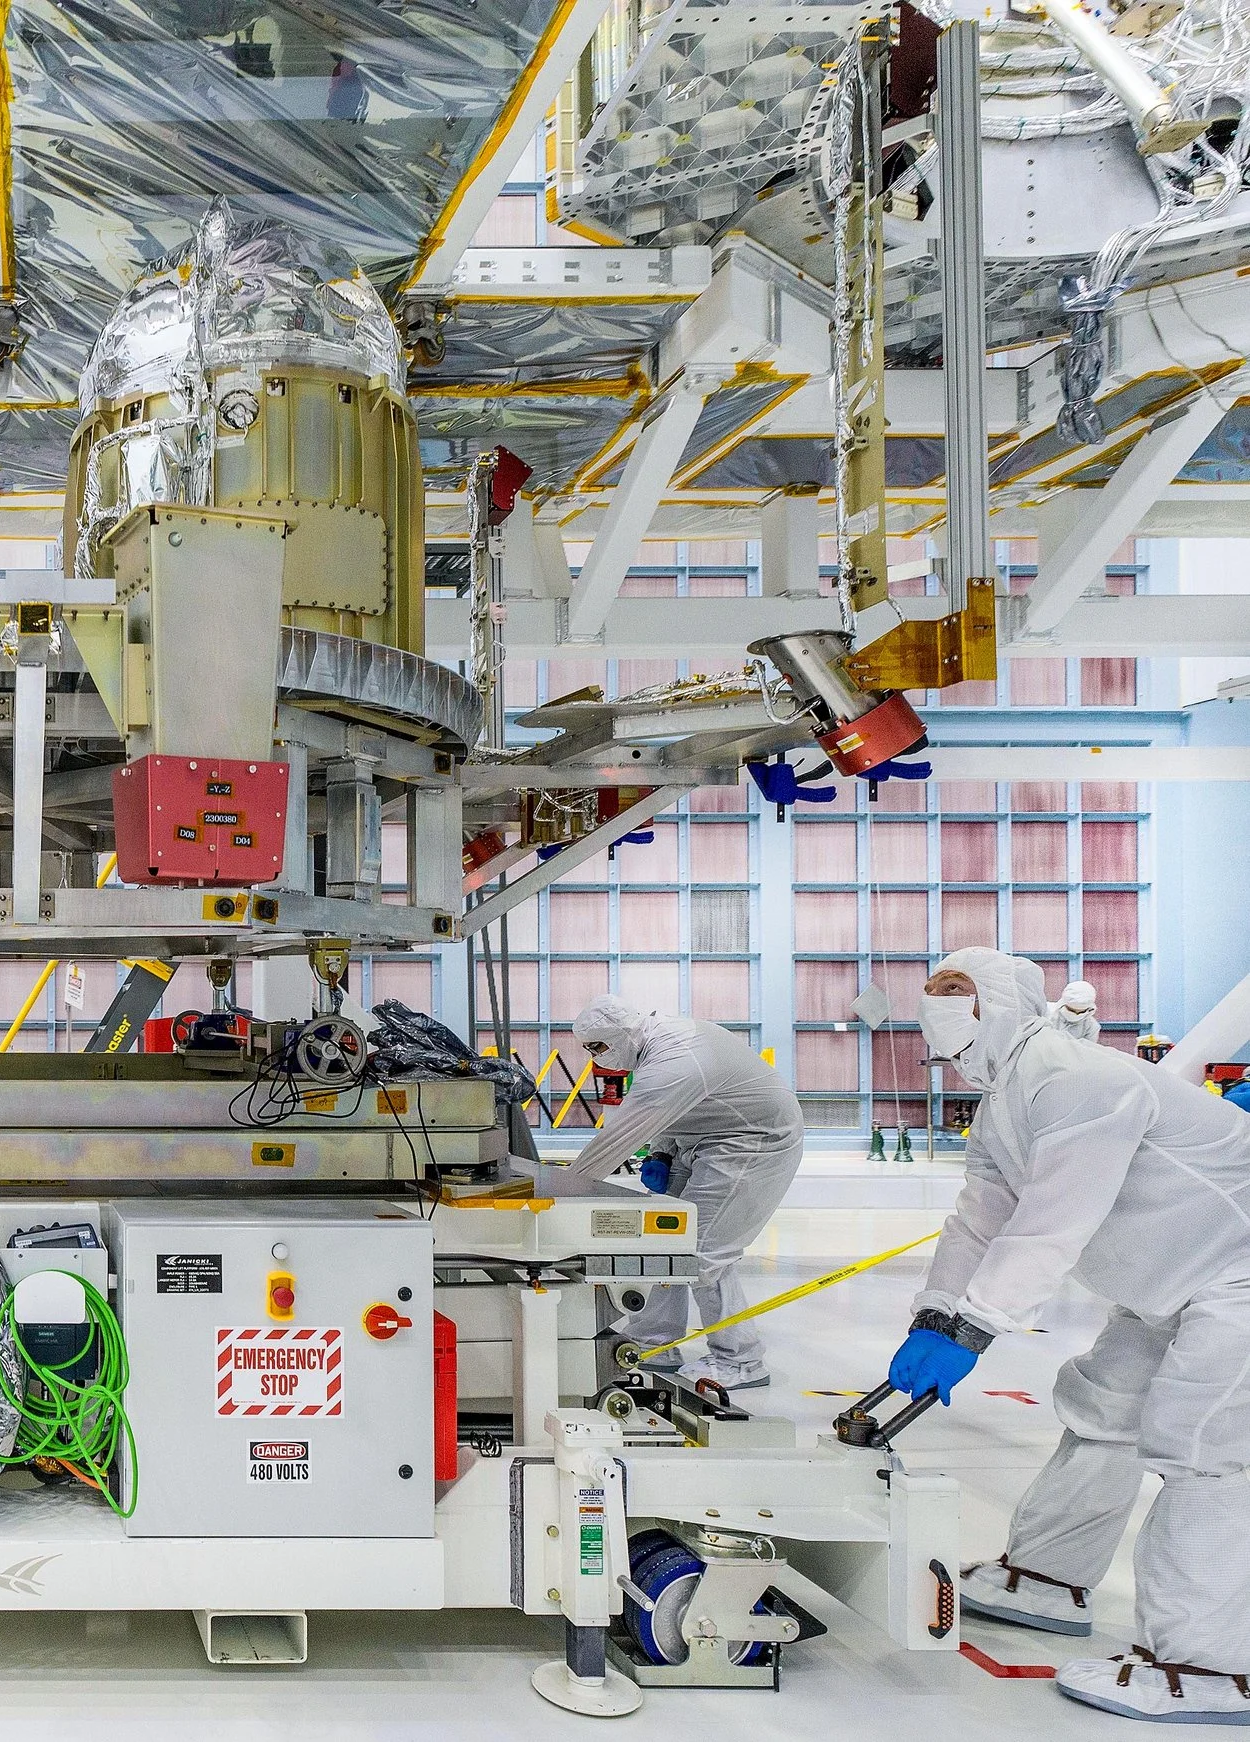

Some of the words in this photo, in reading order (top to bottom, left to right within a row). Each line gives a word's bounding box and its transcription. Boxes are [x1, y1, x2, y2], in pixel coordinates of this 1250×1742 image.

[205, 814, 237, 823] 2300380
[234, 1348, 326, 1370] EMERGENCY
[260, 1374, 299, 1396] STOP
[256, 1445, 303, 1457] DANGER
[250, 1463, 273, 1480] 480
[276, 1463, 309, 1480] VOLTS
